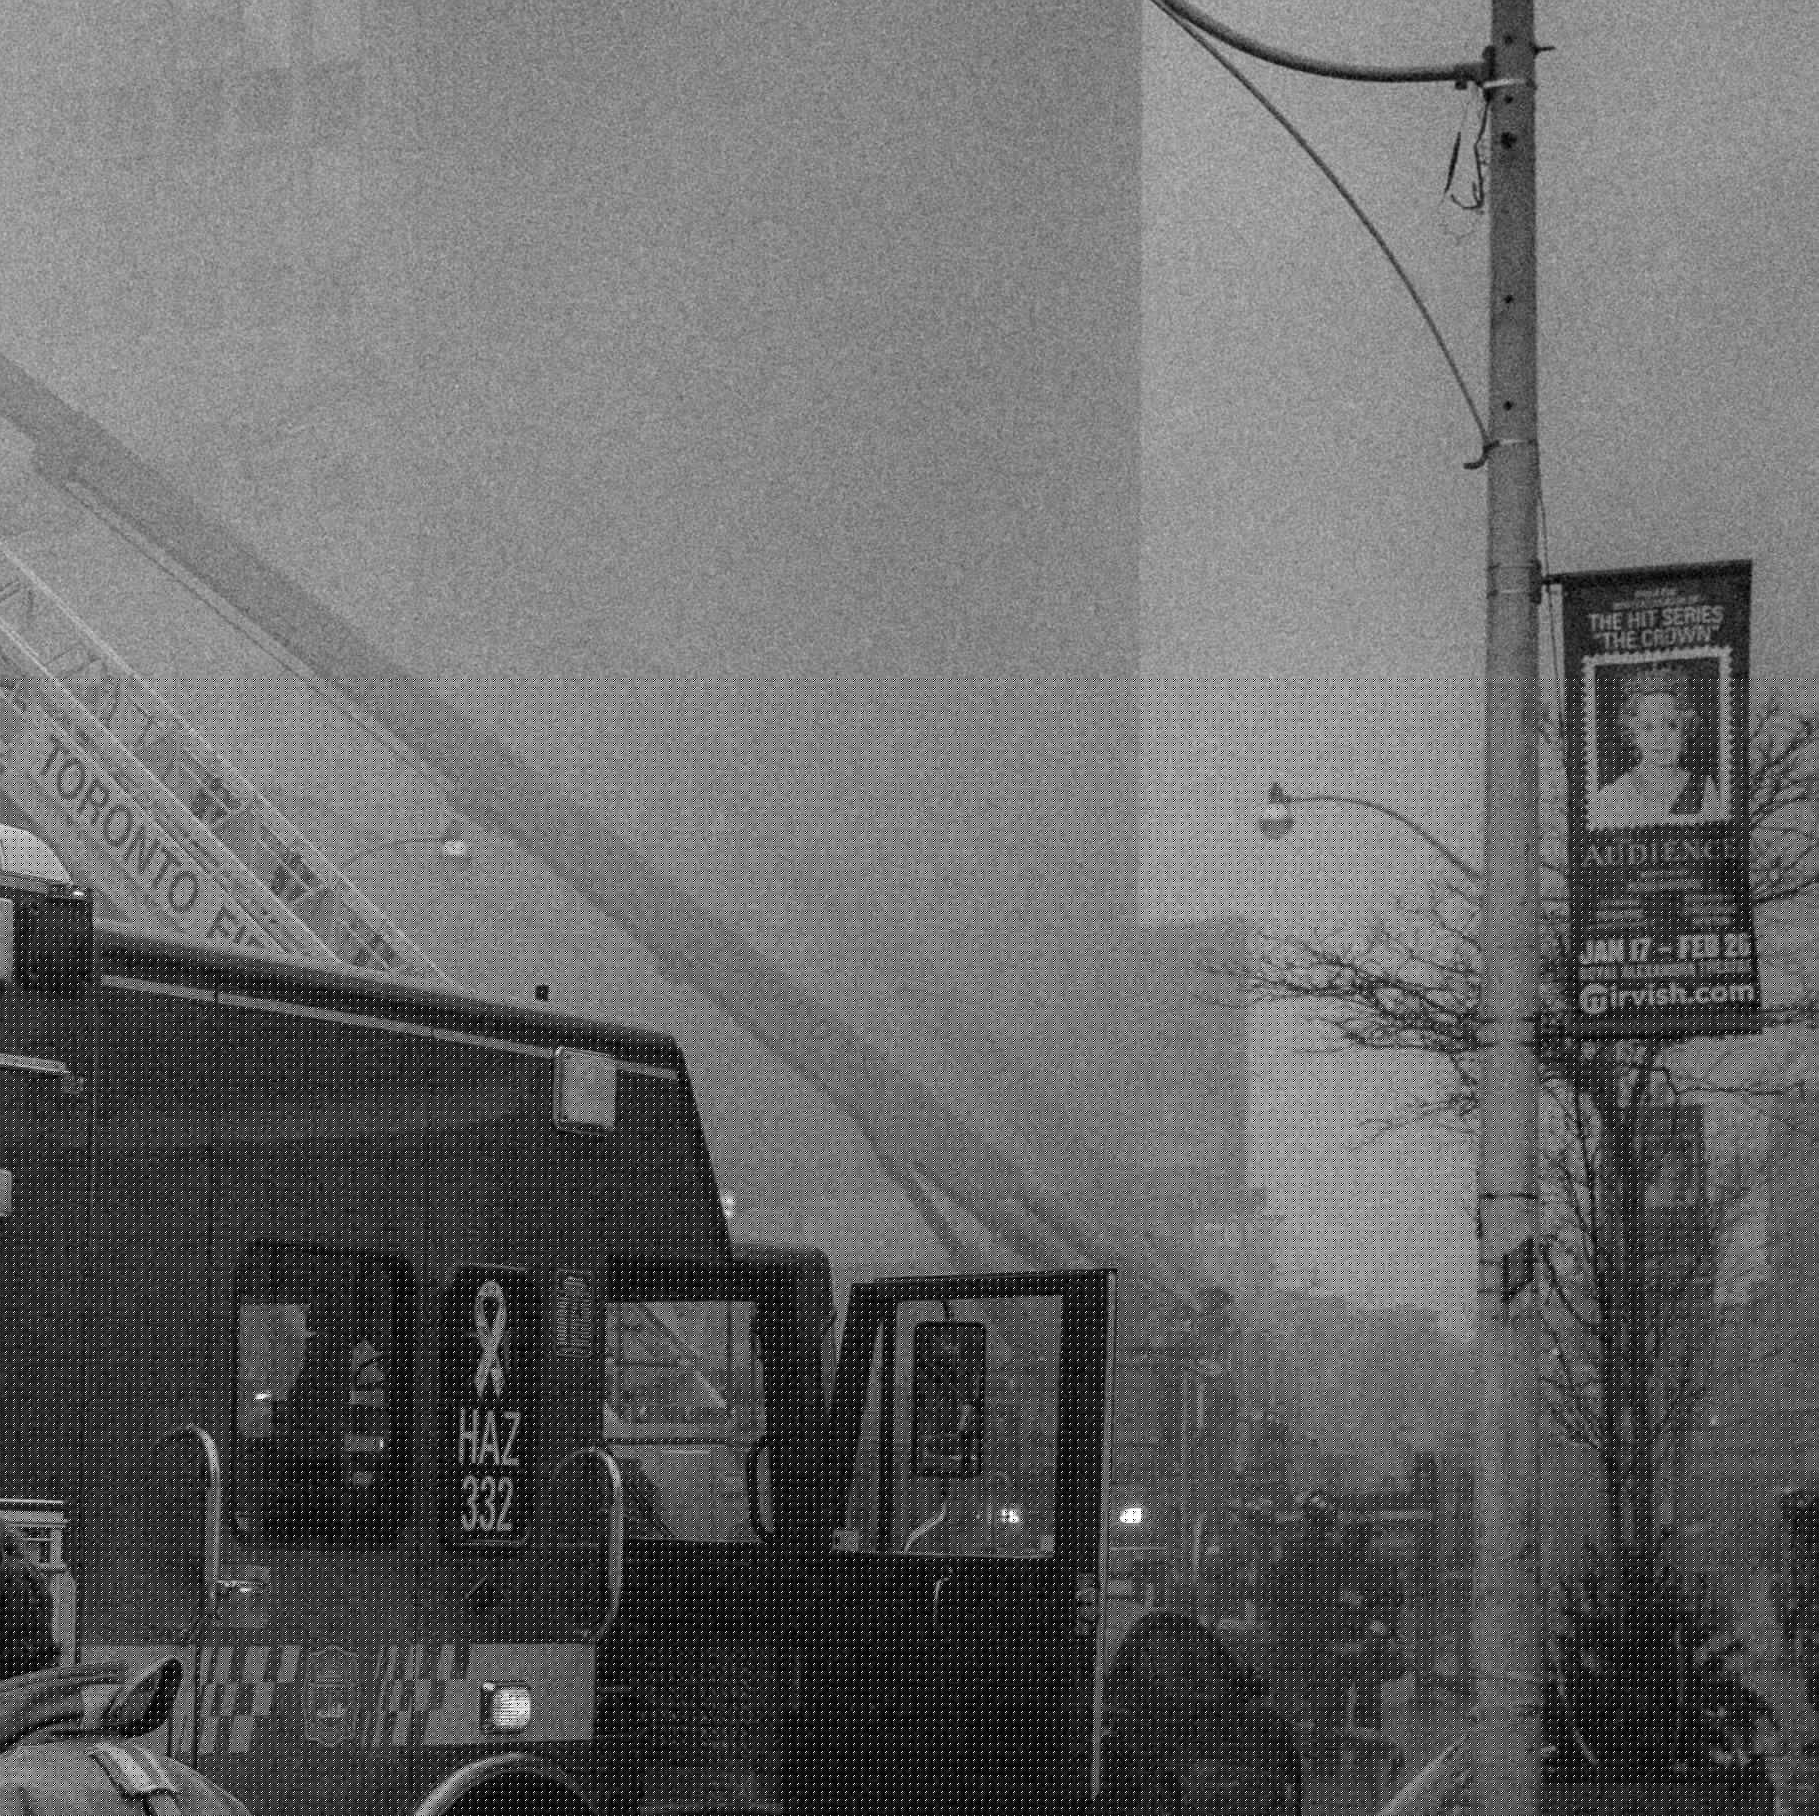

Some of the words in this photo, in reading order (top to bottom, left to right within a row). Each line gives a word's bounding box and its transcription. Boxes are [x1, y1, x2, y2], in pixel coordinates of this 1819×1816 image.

[1588, 613, 1622, 631] THE
[1628, 609, 1658, 628] HIT
[1661, 605, 1725, 626] SERIES
[39, 734, 201, 915] TORONTO
[1582, 838, 1738, 867] AUDIENCE
[1579, 938, 1625, 965] JAN
[1631, 937, 1653, 962] 17
[1678, 934, 1719, 960] FEB
[1724, 933, 1751, 958] 26
[458, 1407, 522, 1467] HAZ
[460, 1474, 514, 1533] 332
